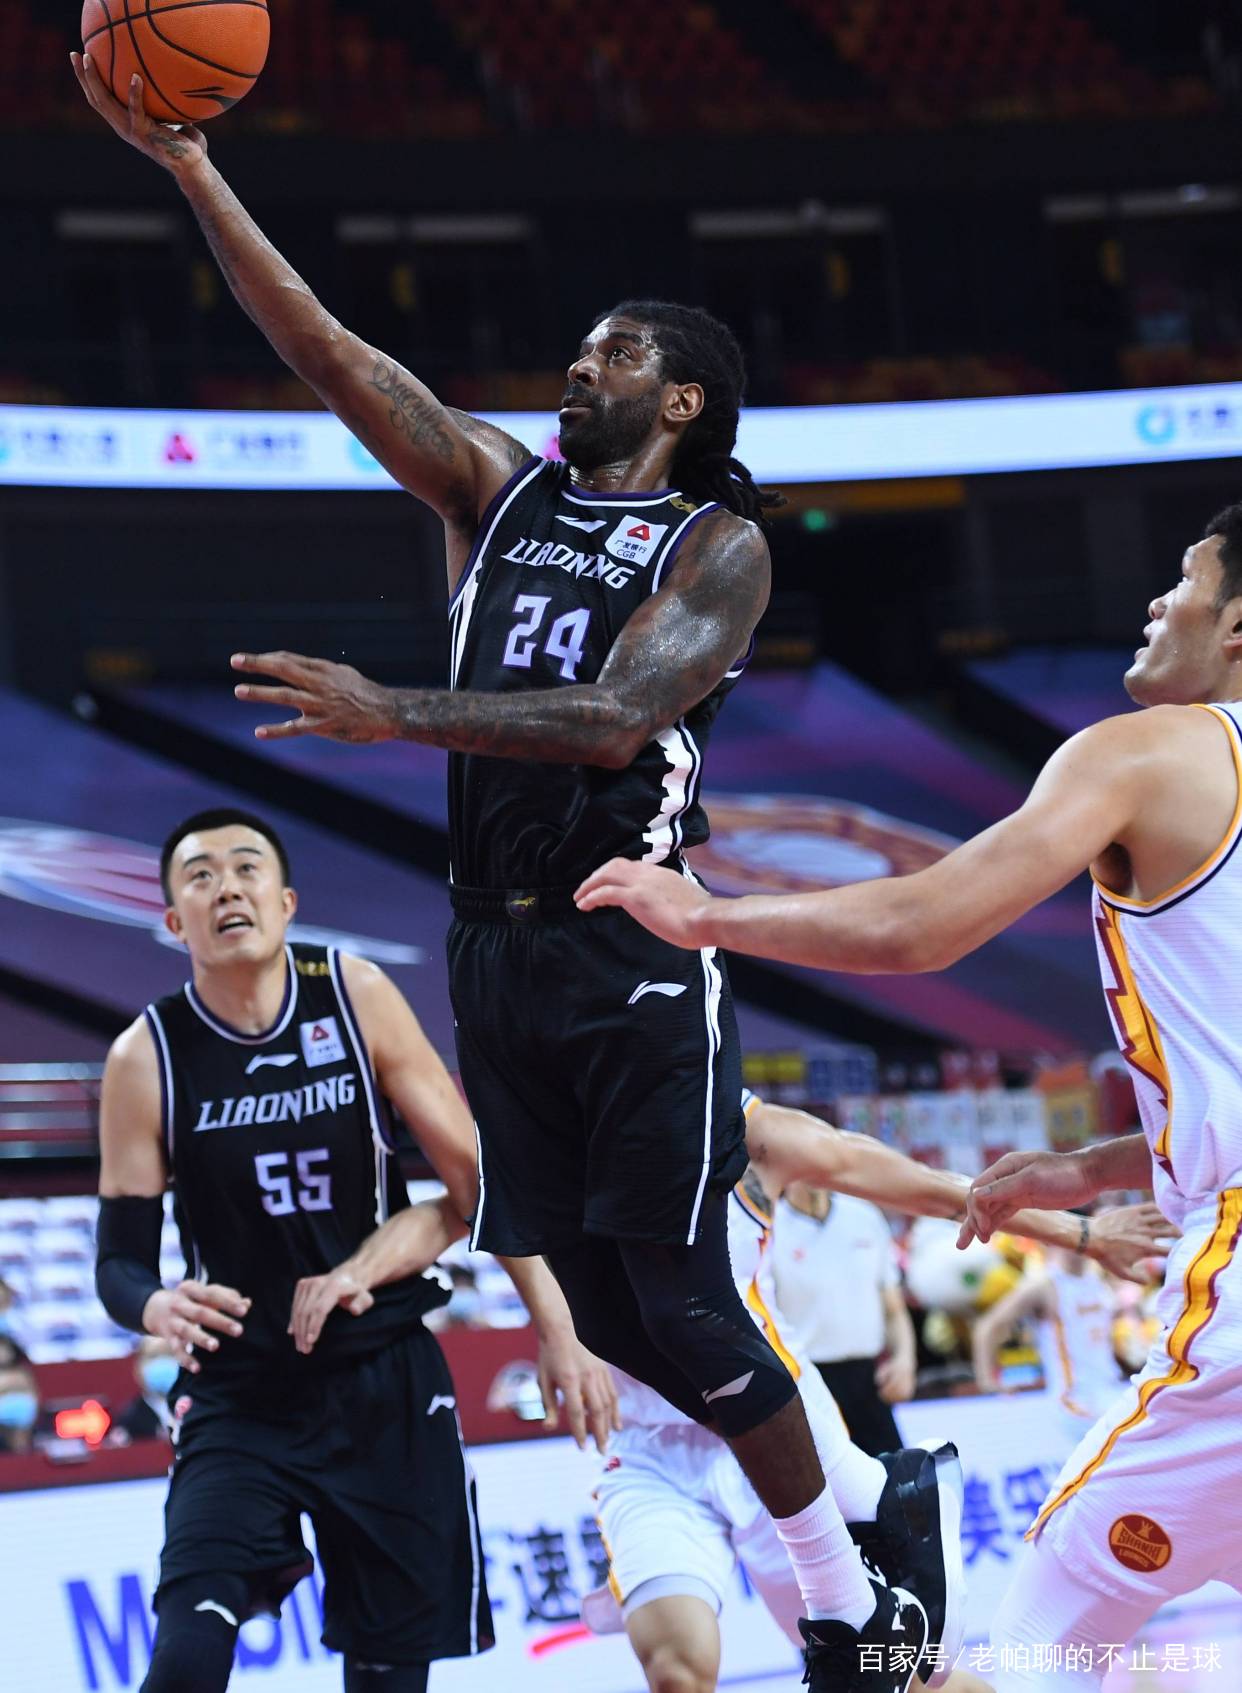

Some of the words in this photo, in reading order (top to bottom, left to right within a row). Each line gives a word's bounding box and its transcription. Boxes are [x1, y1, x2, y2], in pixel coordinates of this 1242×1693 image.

[617, 549, 636, 559] CGB
[502, 594, 590, 680] 24
[194, 1074, 356, 1132] LIAONING
[254, 1148, 333, 1217] 55
